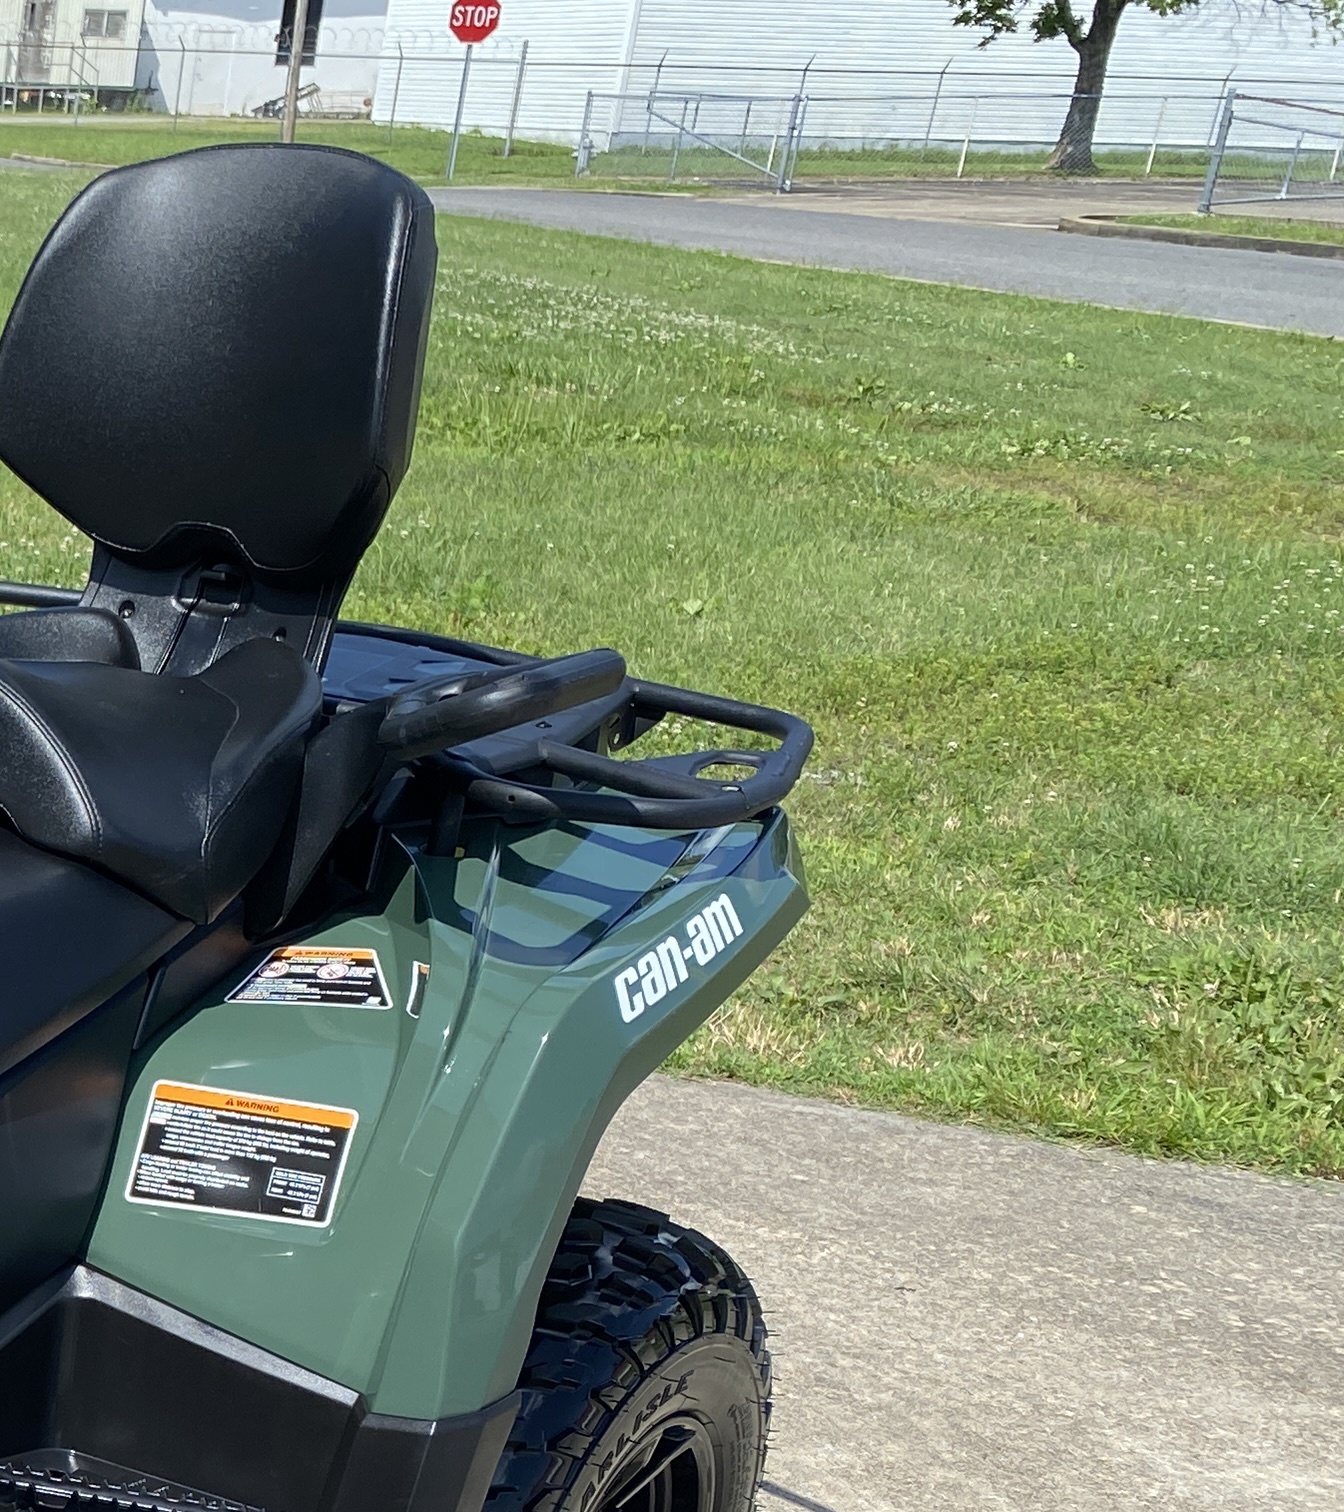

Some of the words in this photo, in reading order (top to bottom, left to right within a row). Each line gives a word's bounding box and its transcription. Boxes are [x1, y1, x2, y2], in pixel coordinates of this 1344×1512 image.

[452, 5, 500, 28] STOP
[614, 892, 745, 1024] can-am
[236, 1099, 280, 1114] WARNING
